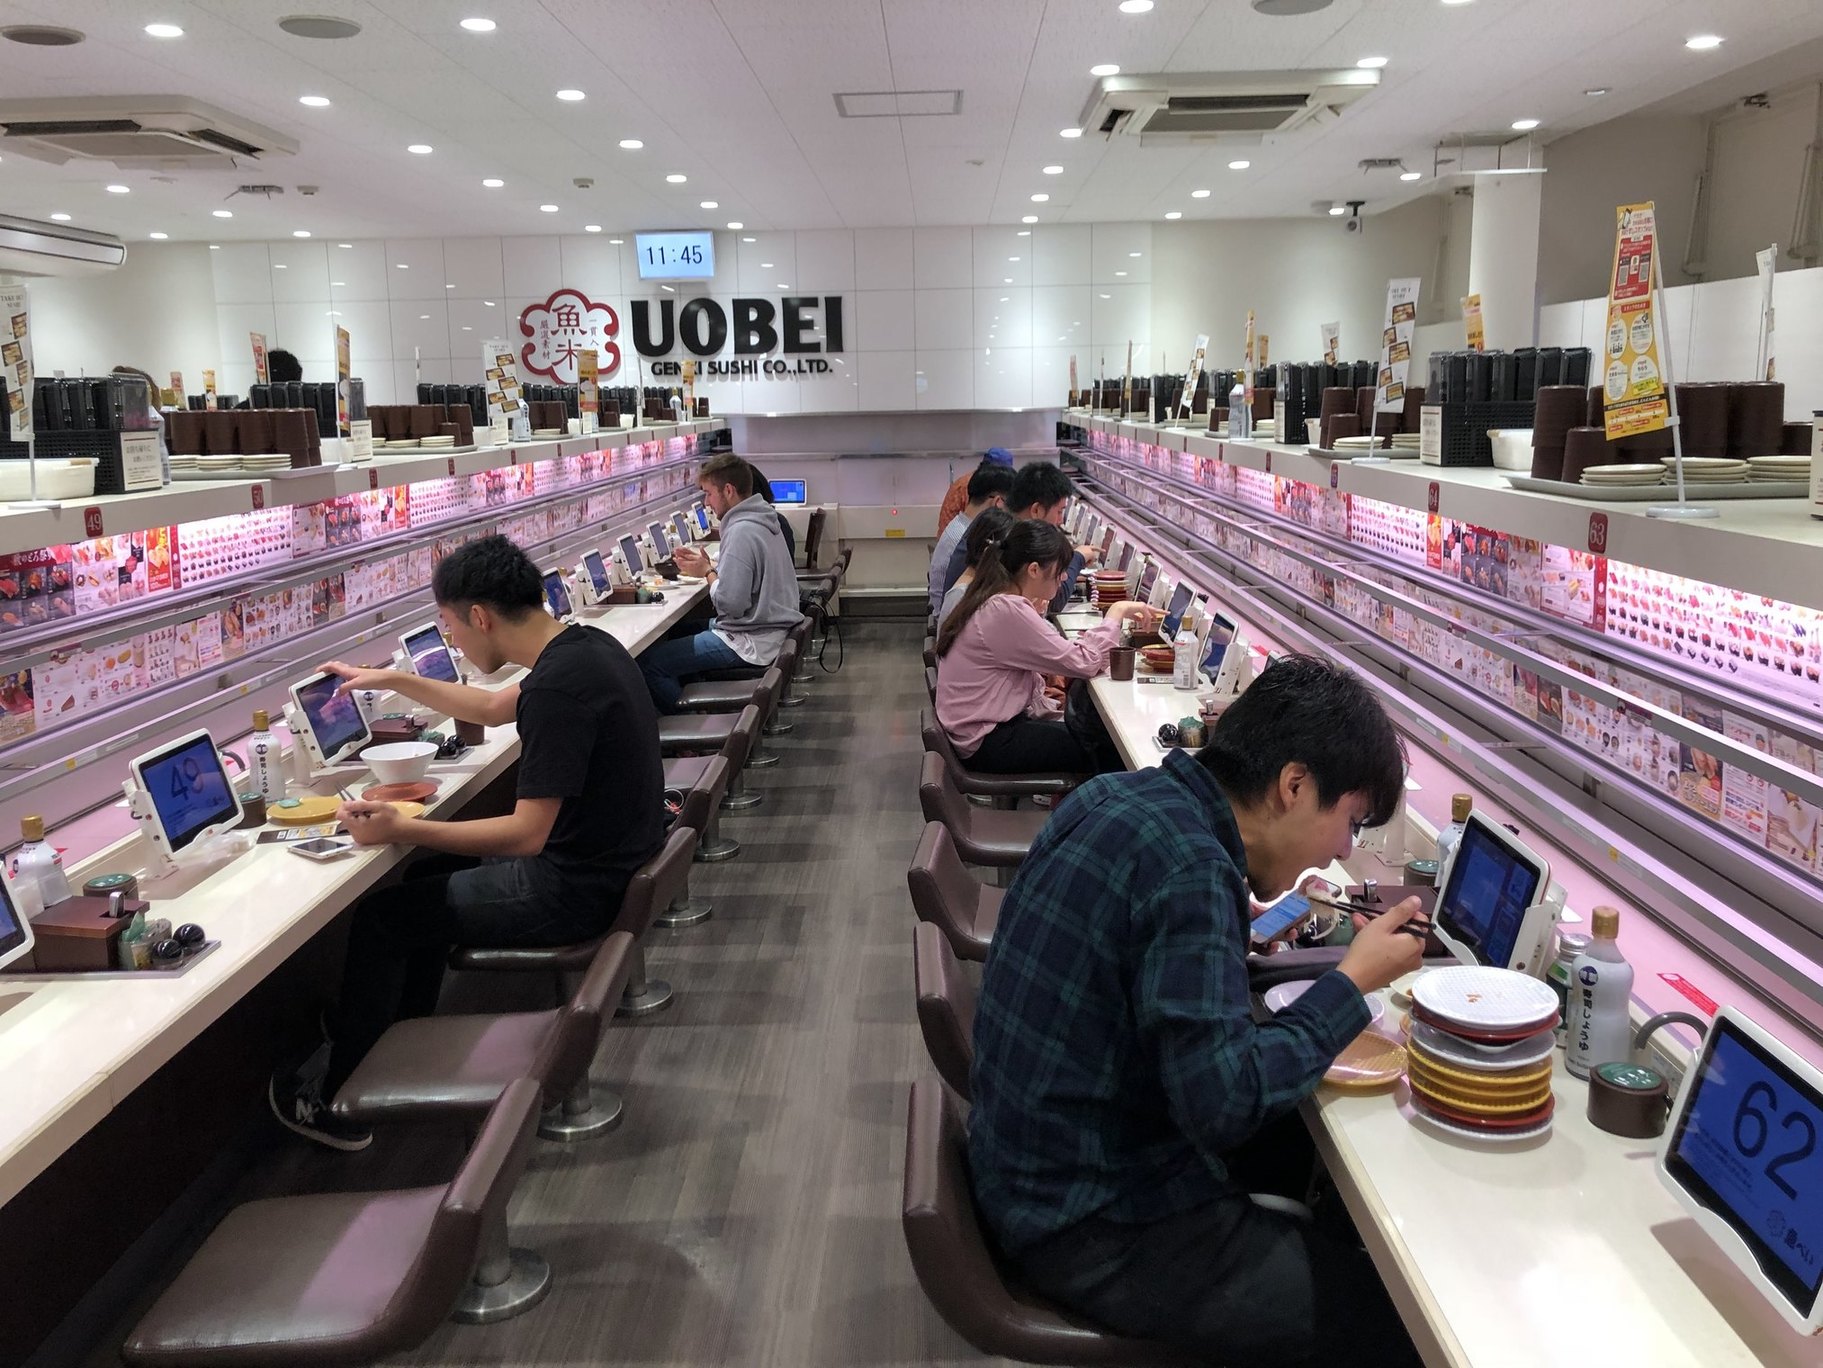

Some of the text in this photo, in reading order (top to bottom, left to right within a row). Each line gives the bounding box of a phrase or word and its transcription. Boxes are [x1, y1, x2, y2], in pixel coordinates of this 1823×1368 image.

[646, 245, 703, 265] 11:45
[630, 295, 844, 356] UOBEI
[650, 361, 703, 376] GENI
[707, 360, 758, 375] SUSHI
[87, 514, 101, 531] 49
[1590, 521, 1605, 546] 63
[170, 756, 204, 801] 49
[1578, 988, 1593, 1051] 寿司しょうゆ
[1732, 1080, 1817, 1201] 62
